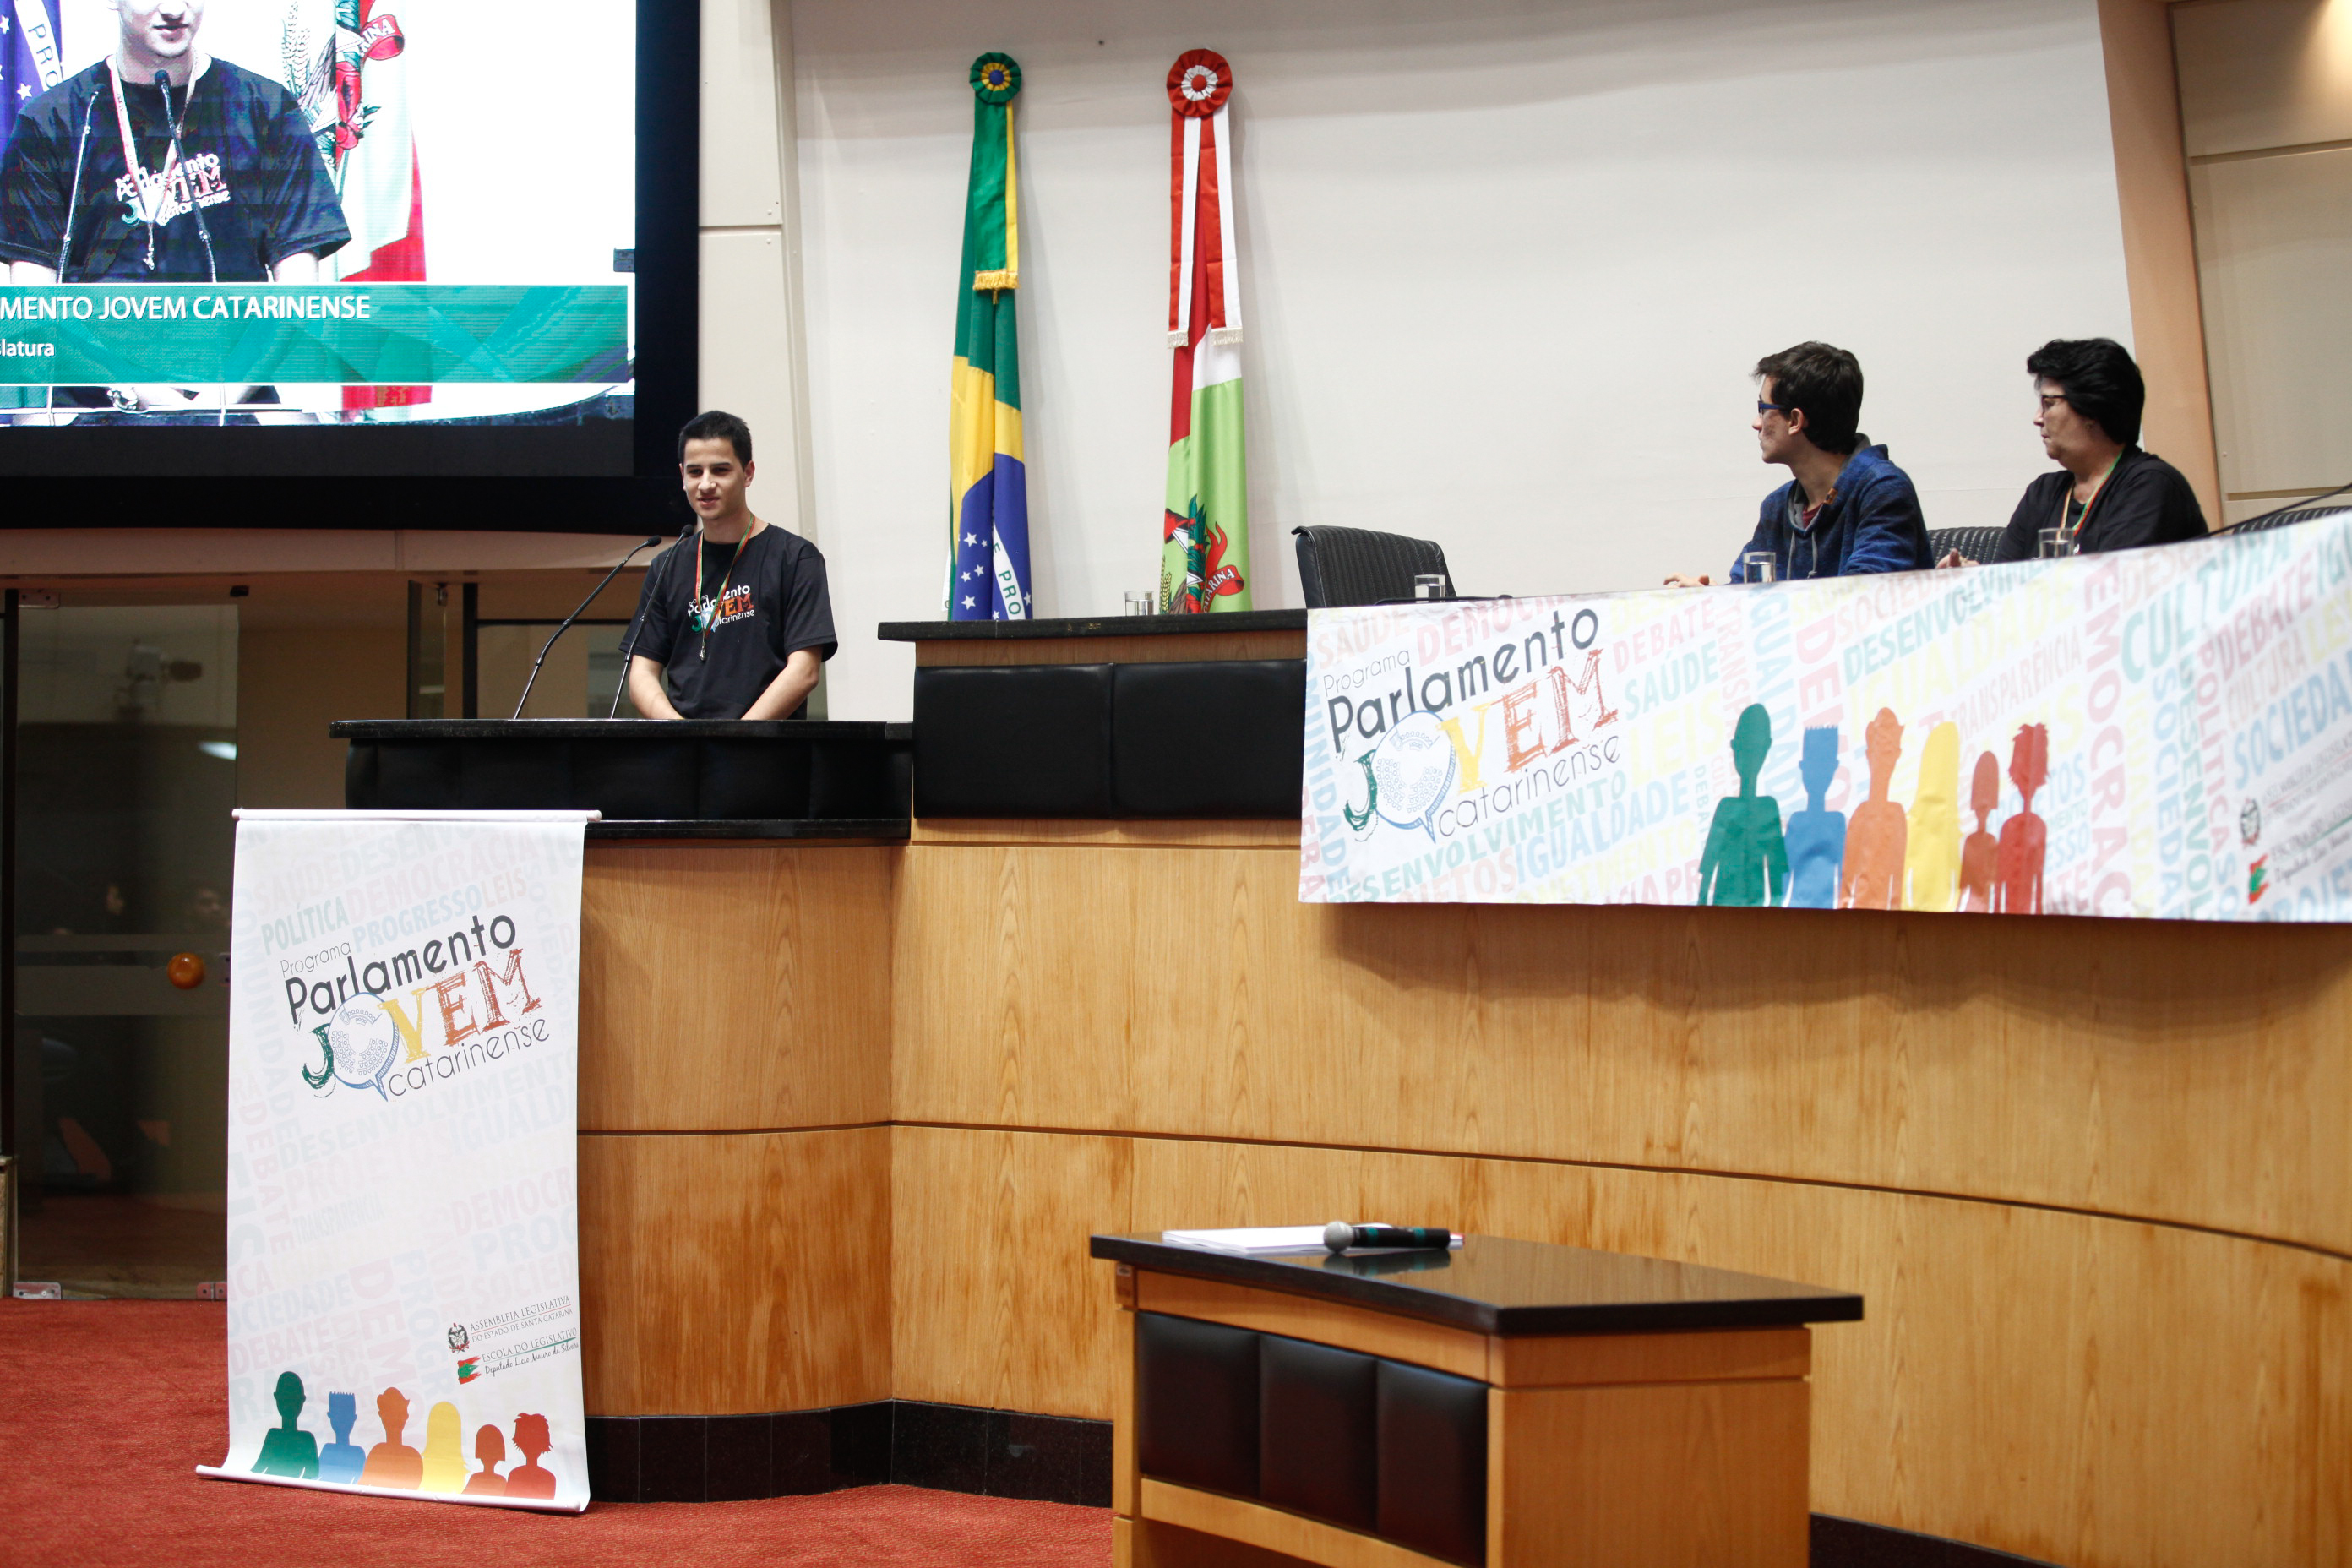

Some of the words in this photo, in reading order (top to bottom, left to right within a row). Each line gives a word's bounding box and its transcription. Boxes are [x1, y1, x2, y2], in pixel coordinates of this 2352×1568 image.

[0, 297, 93, 320] MENTO
[99, 297, 187, 320] JOVEM
[193, 296, 371, 319] CATARINENSE
[0, 338, 55, 357] latura
[998, 570, 1021, 615] PRO
[1613, 596, 1717, 674] DEBATE
[1323, 649, 1411, 697] Programa
[1328, 608, 1600, 754] Parlamento
[1625, 642, 1720, 721] SAÚDE
[1628, 689, 1726, 788] LEIS
[1438, 734, 1622, 838] catarinense
[1516, 770, 1689, 885] IGUALDADE
[345, 830, 539, 924] DEMOCRACIA
[482, 868, 527, 908] LEIS
[261, 896, 350, 956] POLÍTICA
[352, 884, 483, 953] PROGRESSO
[280, 941, 351, 978] Programa
[284, 914, 517, 1025] Parlamento
[388, 1018, 550, 1097] catarinense
[470, 1311, 520, 1332] ASSEMBLEIA
[520, 1295, 571, 1317] LEGISLATIVA
[471, 1335, 482, 1343] DO
[484, 1327, 509, 1341] ESTADO
[521, 1318, 542, 1330] SANTA
[543, 1308, 573, 1323] CATARINA
[482, 1347, 513, 1363] ESCOLA
[514, 1342, 529, 1353] DO
[531, 1327, 577, 1349] LEGISLATIVO
[485, 1359, 514, 1378] Deputado
